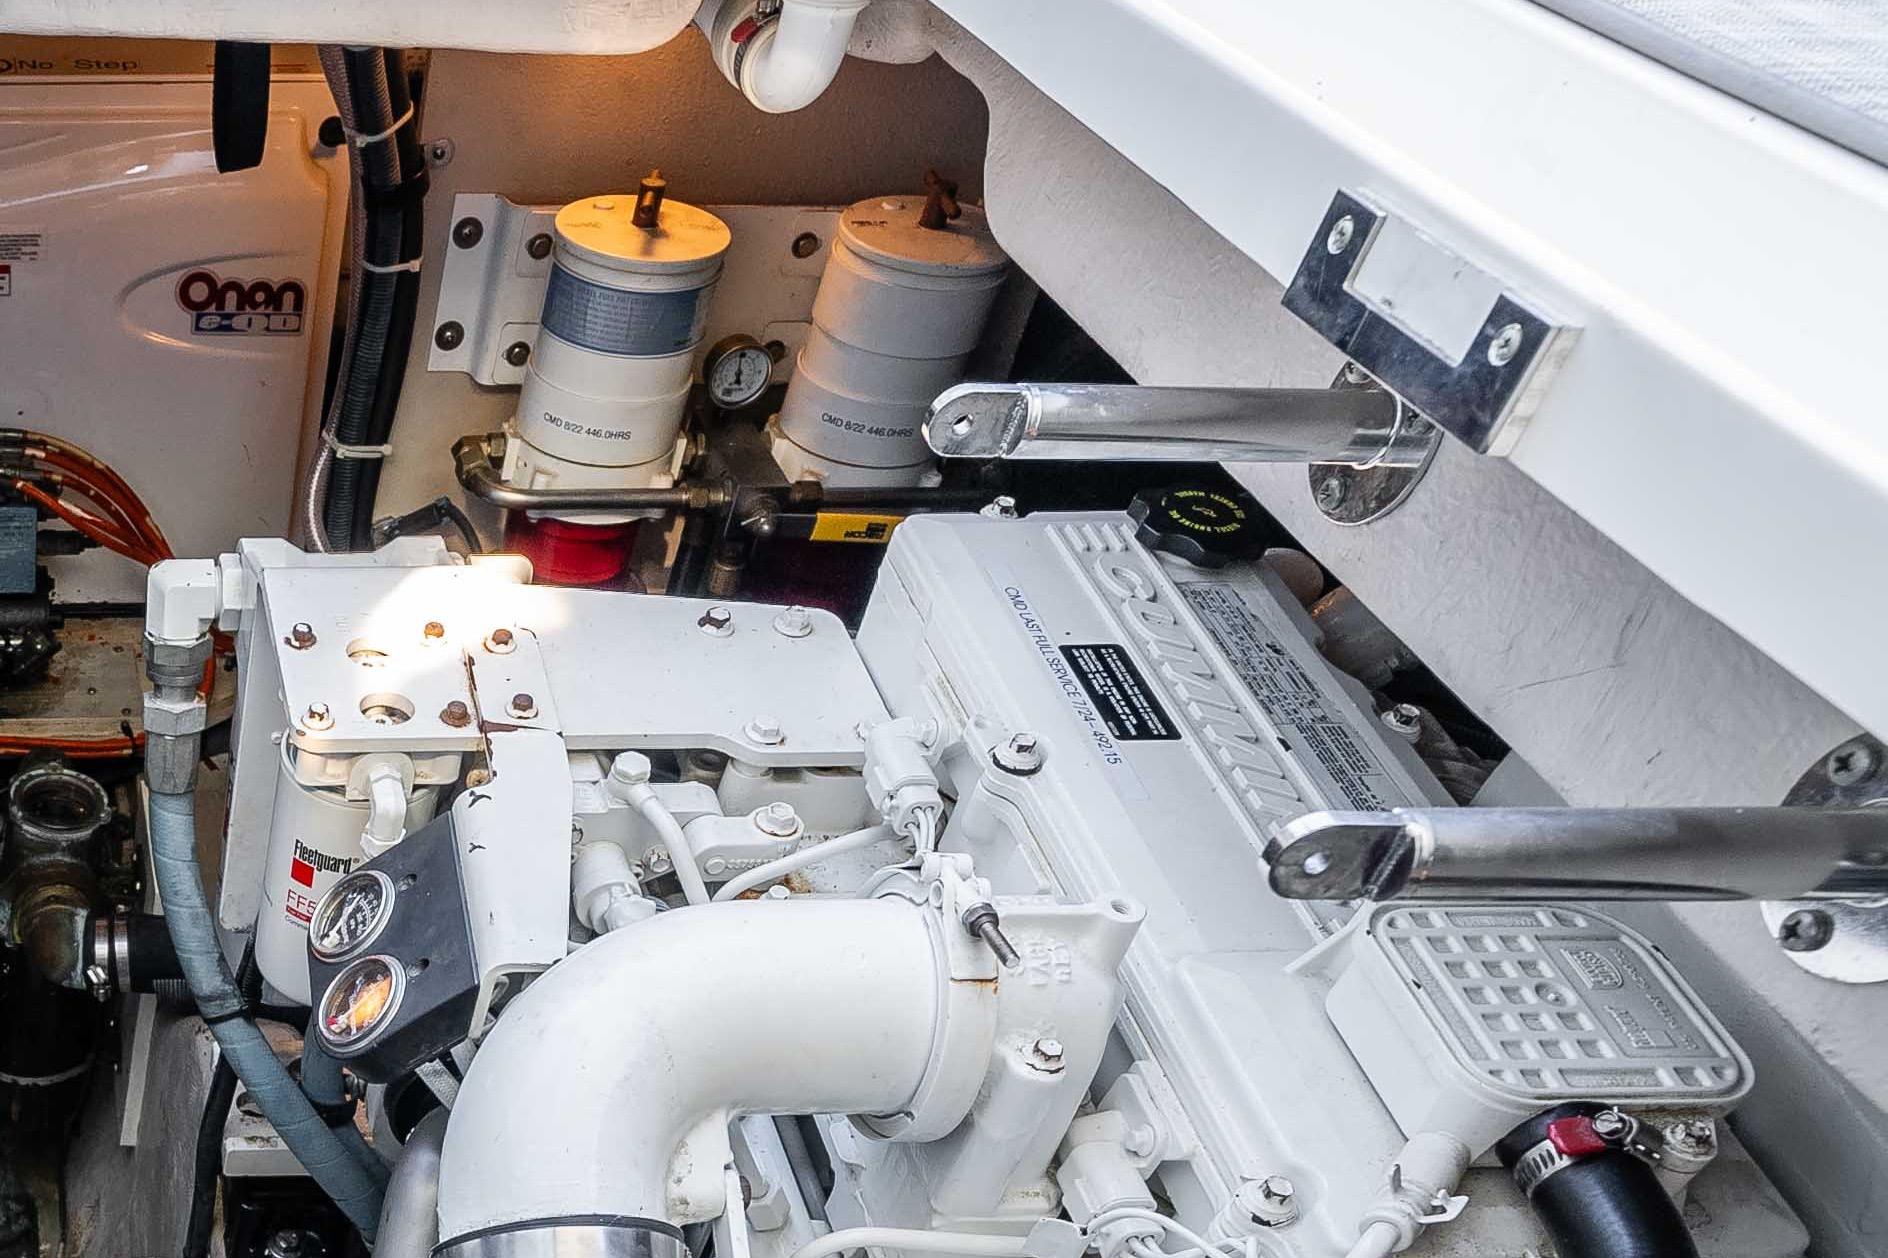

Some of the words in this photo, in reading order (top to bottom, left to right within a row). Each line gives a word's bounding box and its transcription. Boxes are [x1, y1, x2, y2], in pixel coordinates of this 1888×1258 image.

[18, 60, 54, 70] No
[73, 58, 138, 71] Step
[178, 271, 305, 312] Onan
[543, 411, 563, 428] CMD
[563, 421, 584, 435] 8/22
[585, 427, 632, 440] 446.0HRS
[821, 412, 843, 428] CMD
[844, 420, 866, 434] 8/22
[867, 426, 914, 437] 446.0HRS
[1004, 584, 1029, 612] CMD
[1019, 609, 1045, 633] LAST
[1033, 633, 1056, 657] FULL
[1046, 656, 1082, 700] SERVICE
[1091, 728, 1122, 766] 492.15
[286, 888, 317, 915] FF5
